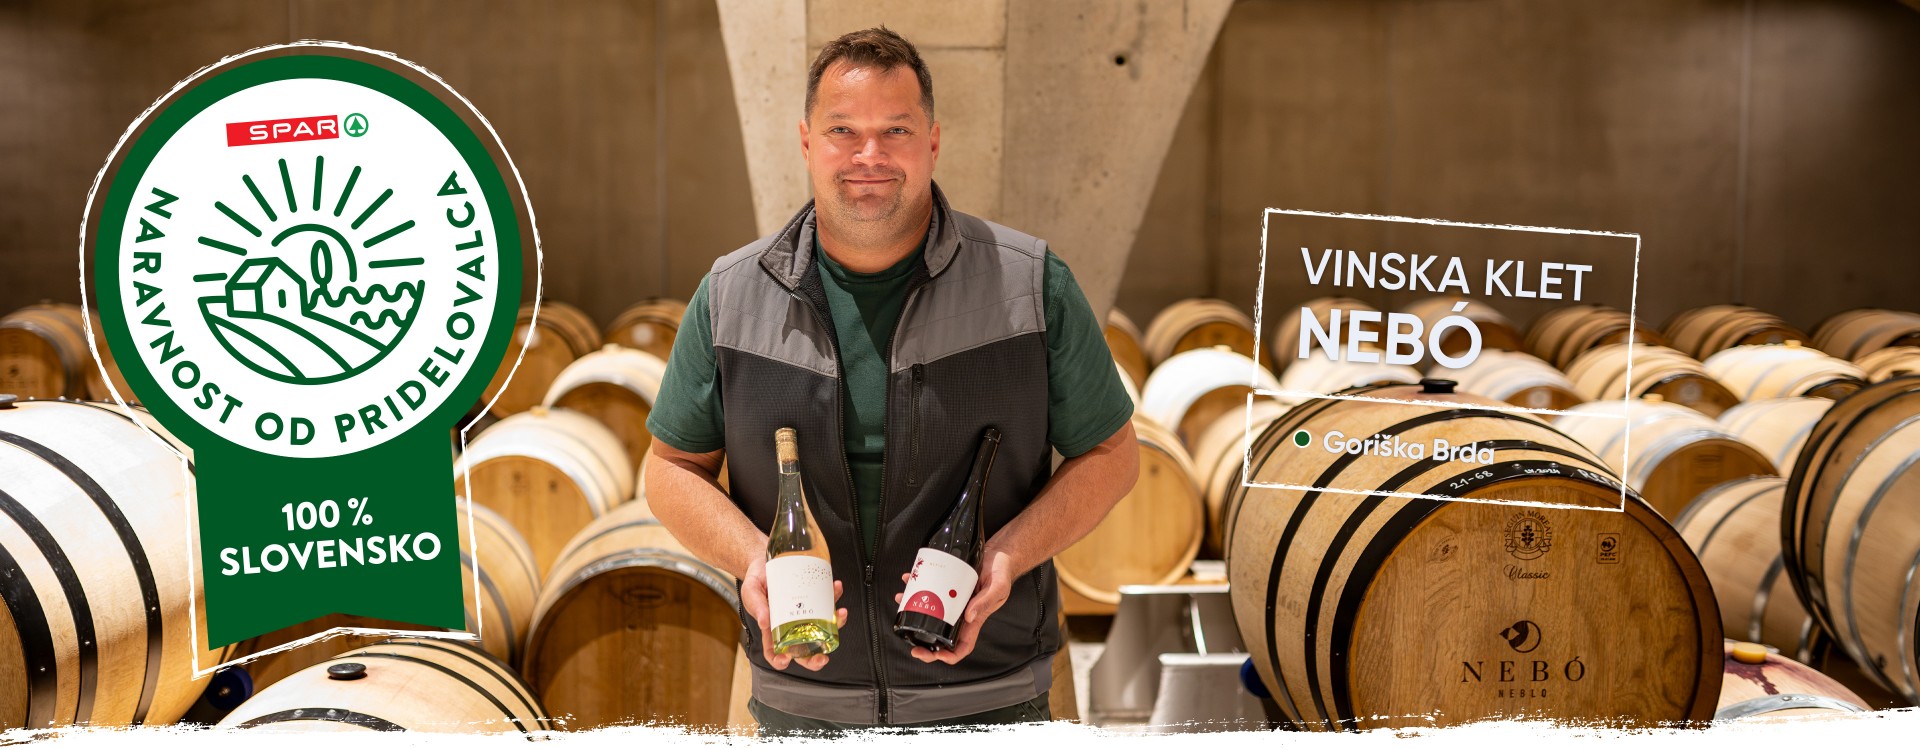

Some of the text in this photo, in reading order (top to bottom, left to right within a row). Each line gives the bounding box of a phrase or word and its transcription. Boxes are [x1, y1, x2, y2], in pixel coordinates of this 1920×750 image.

[1449, 470, 1494, 490] 21-68
[1504, 510, 1552, 538] SEGUIN MOREAU
[1503, 564, 1550, 581] Classic
[1461, 656, 1585, 682] NEBÓ
[1498, 688, 1547, 698] NEBLO
